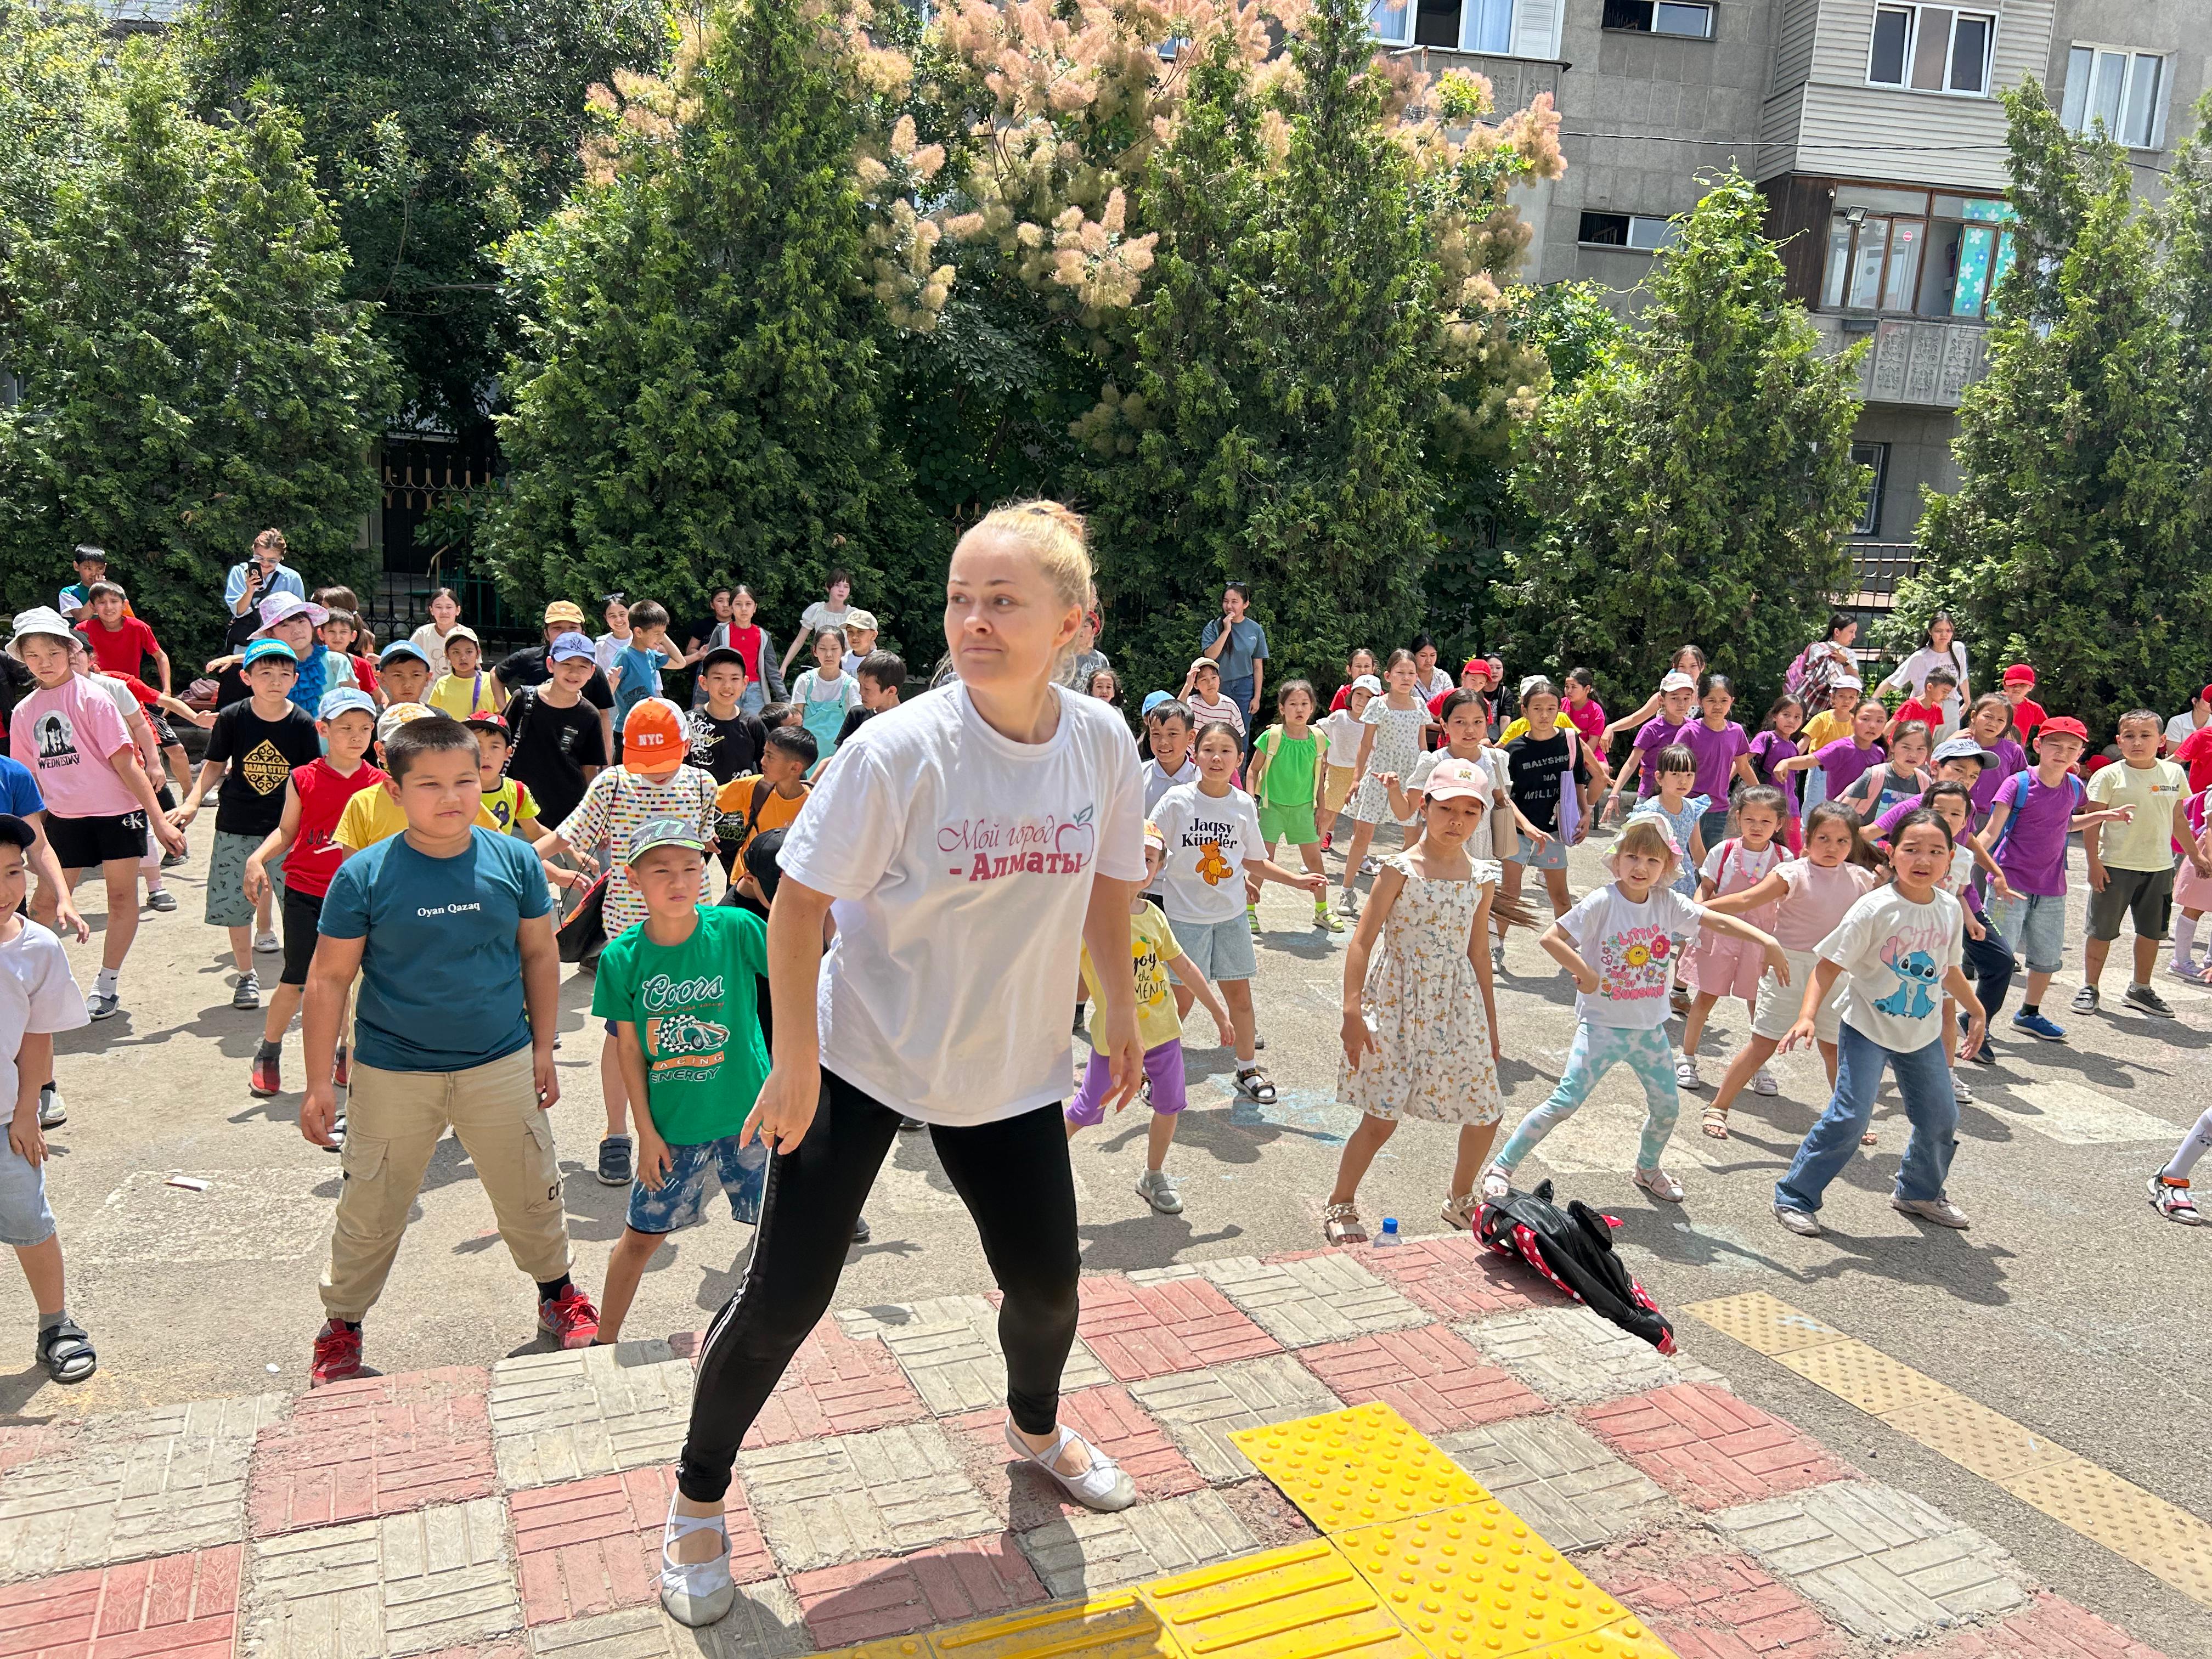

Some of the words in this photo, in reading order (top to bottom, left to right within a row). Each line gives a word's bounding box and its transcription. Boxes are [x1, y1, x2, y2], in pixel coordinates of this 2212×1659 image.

[638, 733, 664, 746] NYC
[268, 765, 289, 774] STYLE
[1522, 753, 1570, 770] MALYSHK
[1543, 773, 1557, 782] NA
[937, 819, 1000, 852] Мой
[1006, 815, 1054, 853] город
[1189, 817, 1234, 838] Jaqsy
[1181, 833, 1238, 849] Künder
[969, 851, 1083, 882] Алматы
[417, 907, 445, 918] Oyan
[447, 902, 481, 913] Qazaq
[1133, 953, 1157, 977] joy
[1137, 969, 1151, 982] the
[1610, 970, 1631, 980] RAY
[641, 974, 725, 1011] Coors
[1134, 979, 1166, 1000] MENT
[1611, 985, 1665, 1001] SUNSHIN
[658, 1053, 723, 1070] ACING
[650, 1066, 721, 1084] ENERGY
